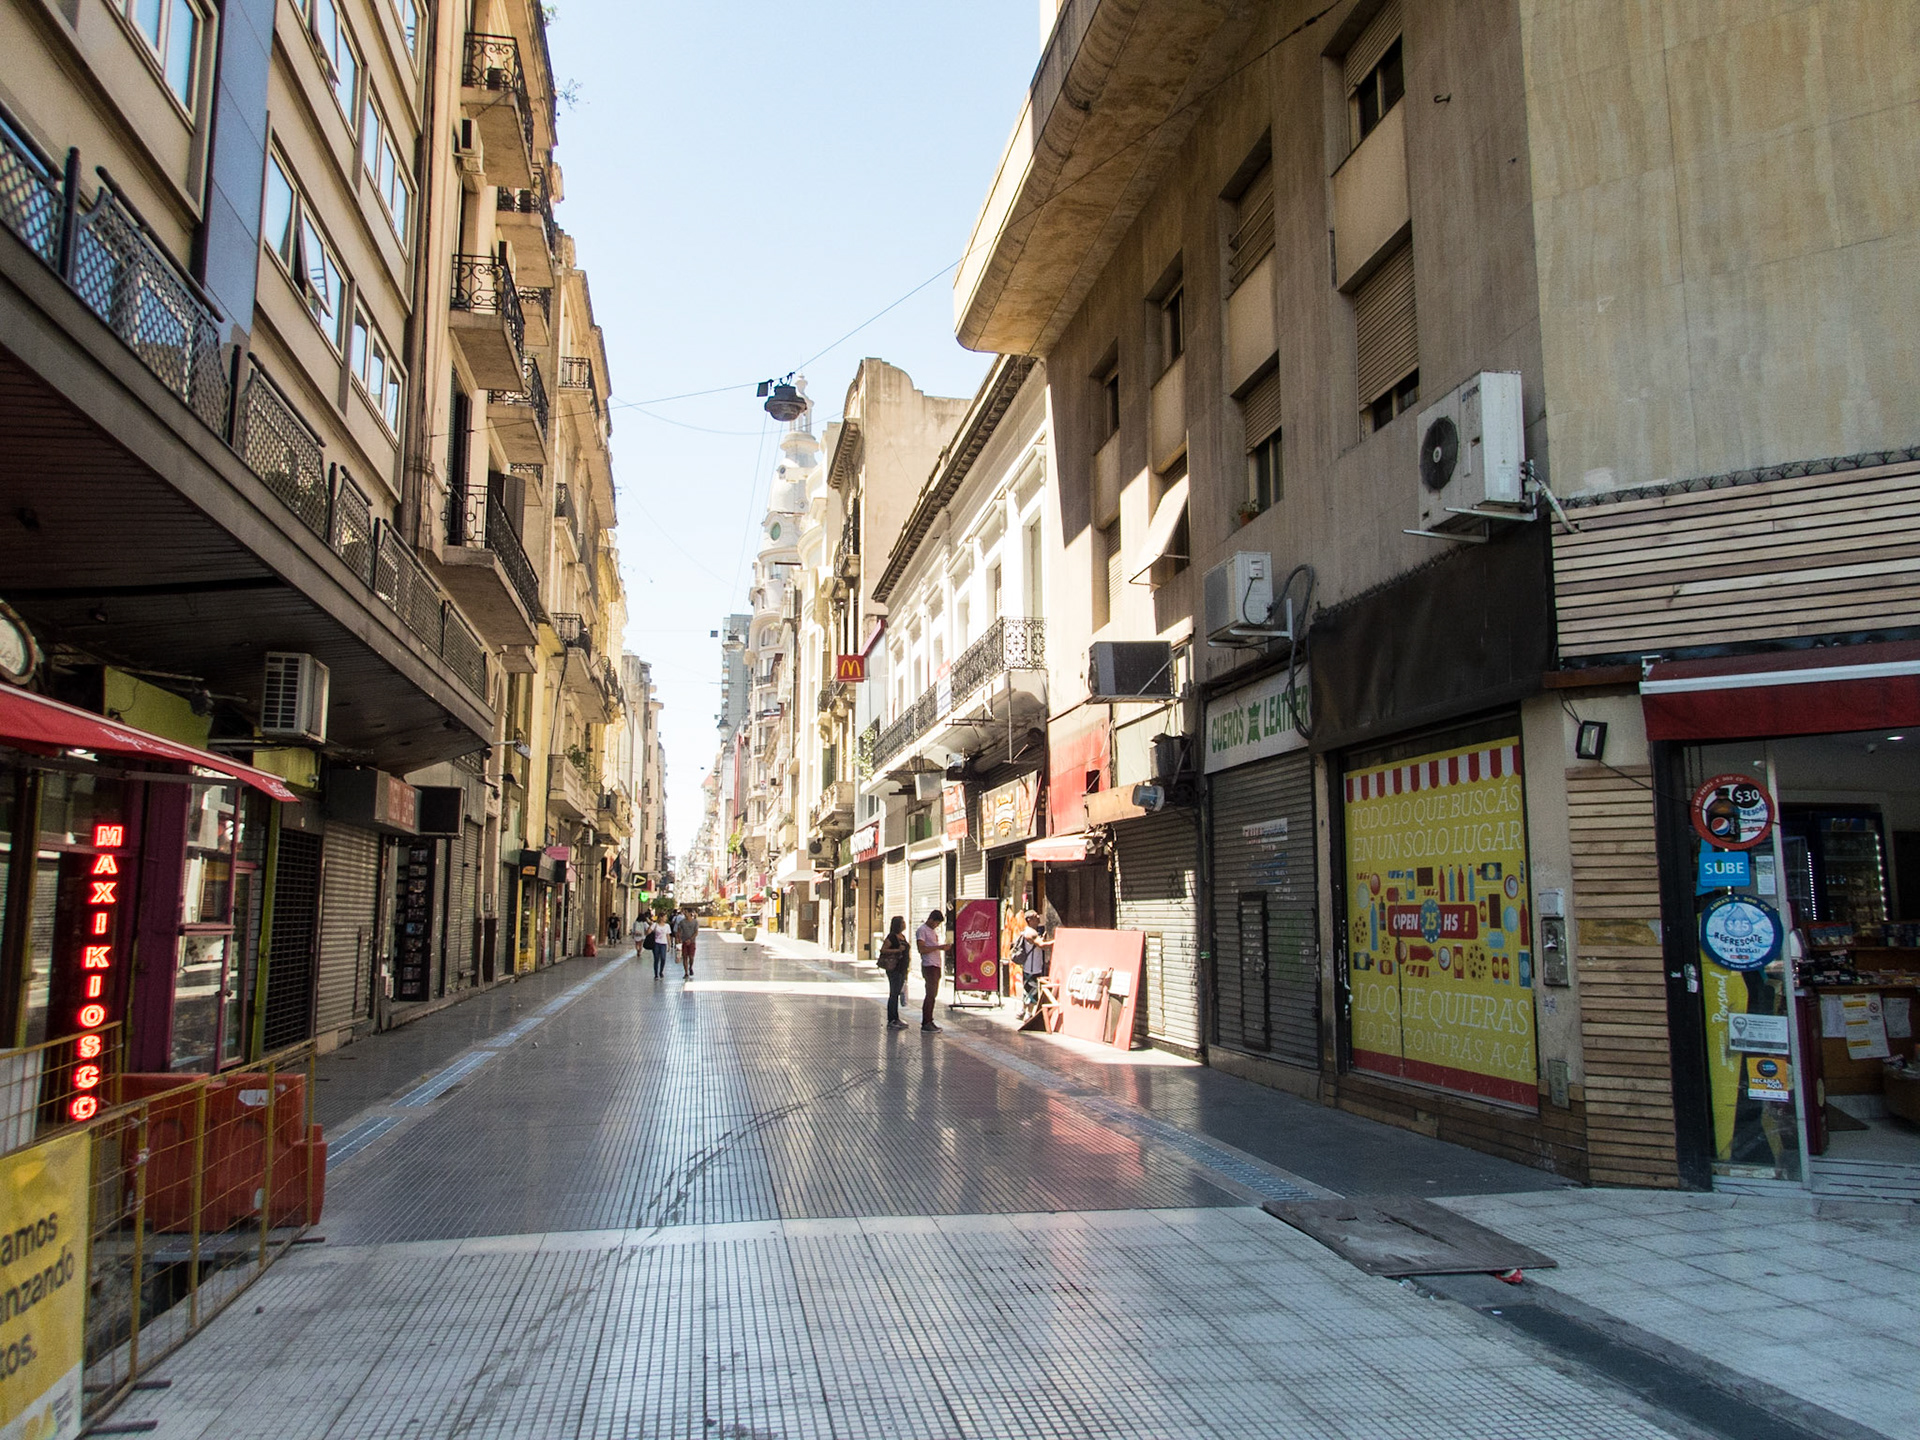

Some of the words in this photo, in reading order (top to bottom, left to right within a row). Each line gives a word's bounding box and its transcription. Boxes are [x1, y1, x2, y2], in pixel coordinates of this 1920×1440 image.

[1211, 706, 1244, 753] CUEROS
[1352, 804, 1389, 830] TODO
[1392, 801, 1412, 826] LO
[1414, 796, 1448, 826] QUE
[1450, 779, 1521, 818] BUSCÁS
[1735, 789, 1760, 803] $30
[1353, 835, 1375, 862] EN
[1377, 830, 1402, 860] UN
[1403, 827, 1450, 858] SOLO
[1452, 820, 1522, 854] LUGAR
[1704, 861, 1745, 875] SUBE
[1393, 913, 1419, 930] OPEN
[1425, 912, 1437, 930] 25
[1443, 913, 1459, 931] HS
[71, 825, 124, 1120] MAXIKIOSCO
[1710, 970, 1729, 1023] Personal
[1357, 983, 1380, 1013] LO
[1383, 985, 1425, 1021] QUE
[1428, 990, 1530, 1036] QUIERAS
[1359, 1020, 1377, 1043] LO
[1381, 1023, 1484, 1063] ENCONTRÁS
[1489, 1041, 1532, 1072] ACÁ
